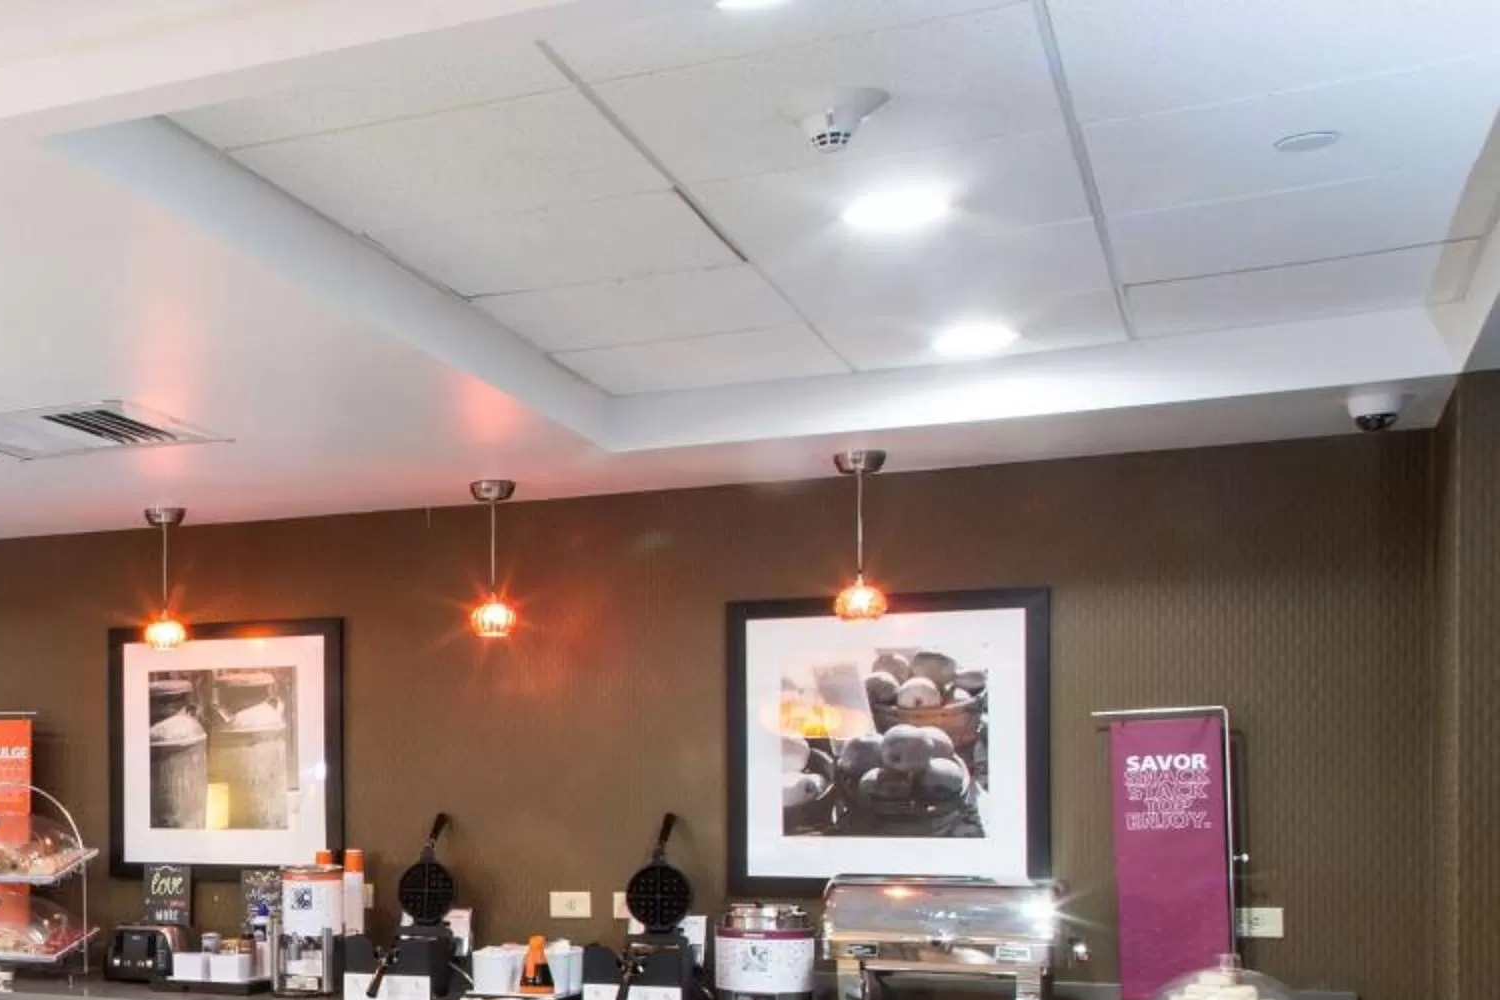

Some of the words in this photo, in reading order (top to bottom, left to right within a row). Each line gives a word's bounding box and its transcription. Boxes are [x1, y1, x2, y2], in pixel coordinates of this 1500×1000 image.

[1126, 753, 1207, 771] SAVOR
[1124, 768, 1211, 787] SNACK
[1127, 783, 1208, 800] STACK
[1144, 798, 1193, 815] TOP
[1125, 811, 1212, 831] ENJOY.
